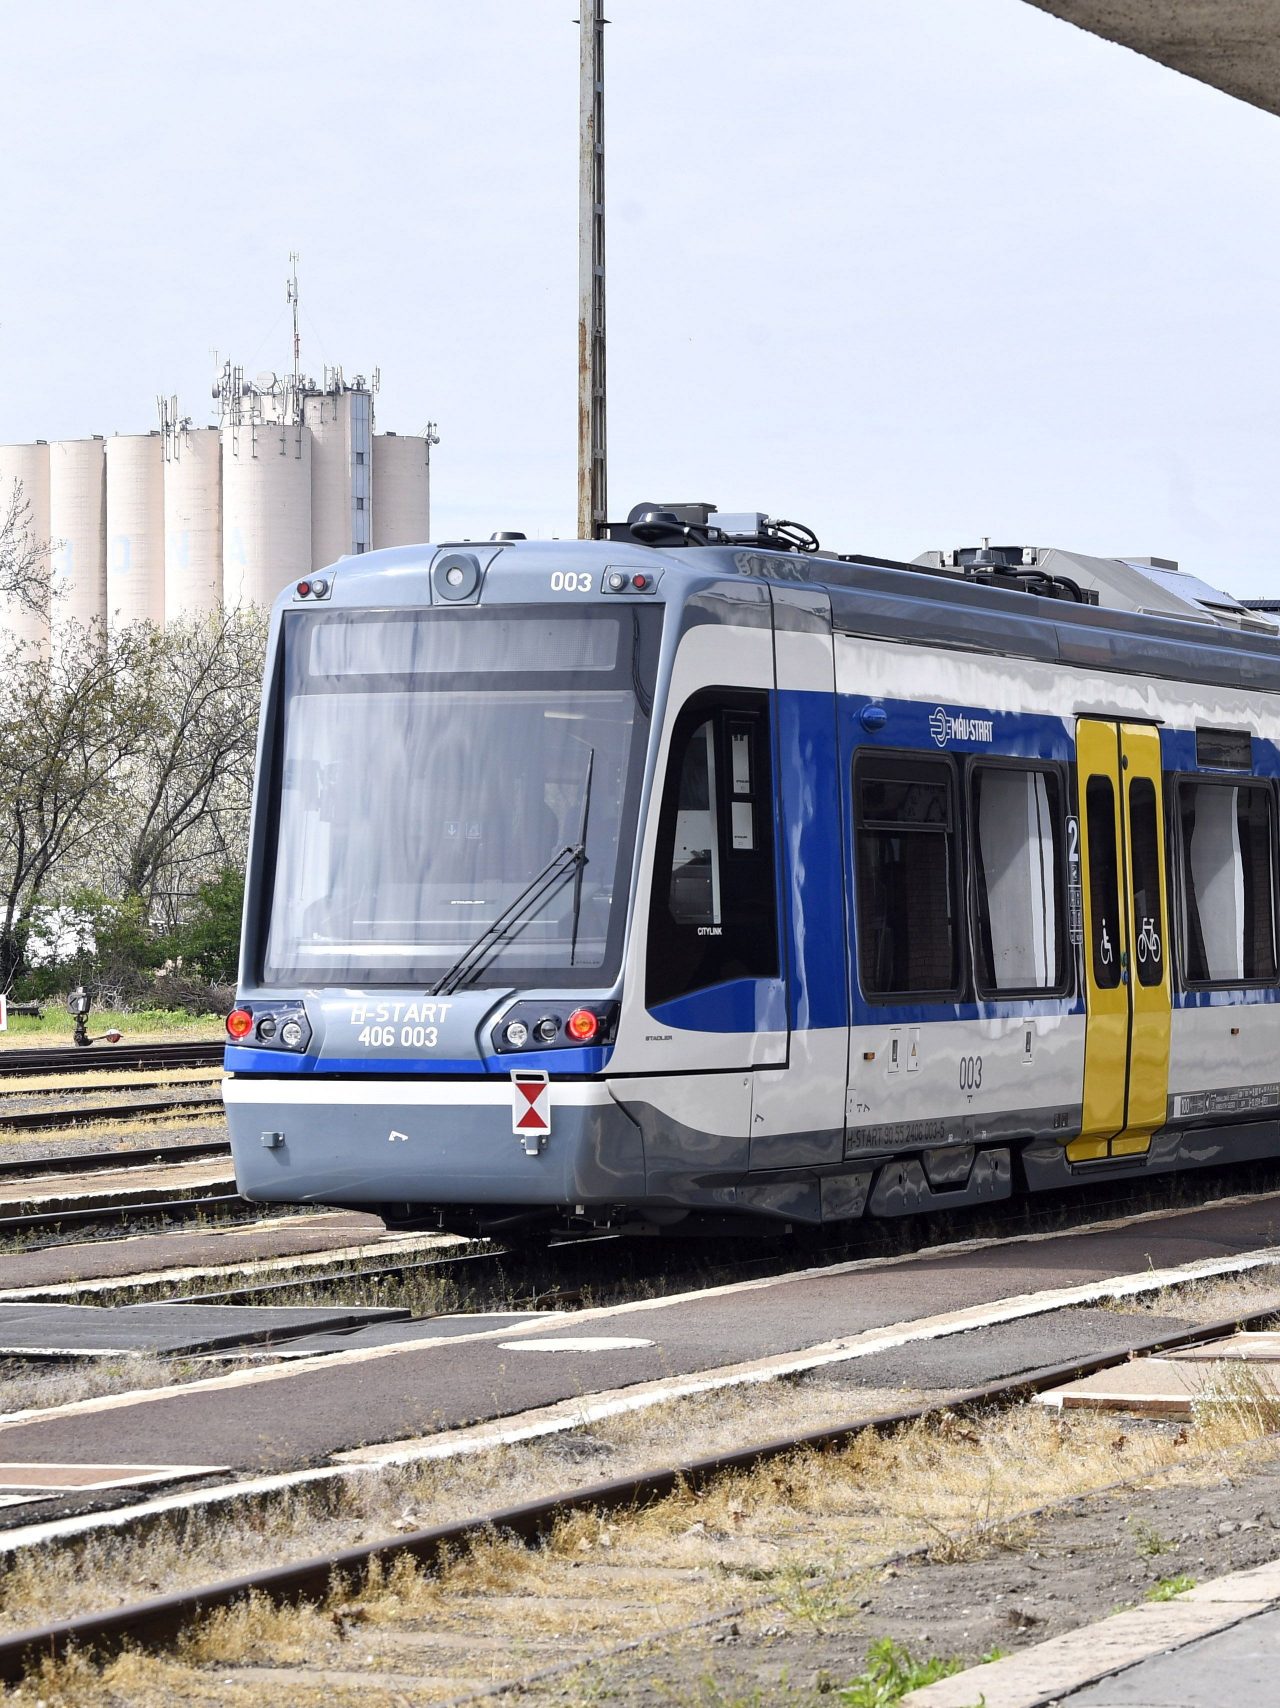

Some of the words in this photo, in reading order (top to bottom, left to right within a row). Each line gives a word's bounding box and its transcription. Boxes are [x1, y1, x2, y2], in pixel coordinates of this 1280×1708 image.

[550, 571, 592, 592] 003
[951, 713, 993, 742] MÁV-START
[1068, 819, 1078, 861] 2
[697, 927, 722, 935] CITYLINK
[351, 1003, 452, 1024] H-START
[359, 1026, 395, 1047] 406
[401, 1026, 439, 1047] 003
[960, 1055, 982, 1090] 003
